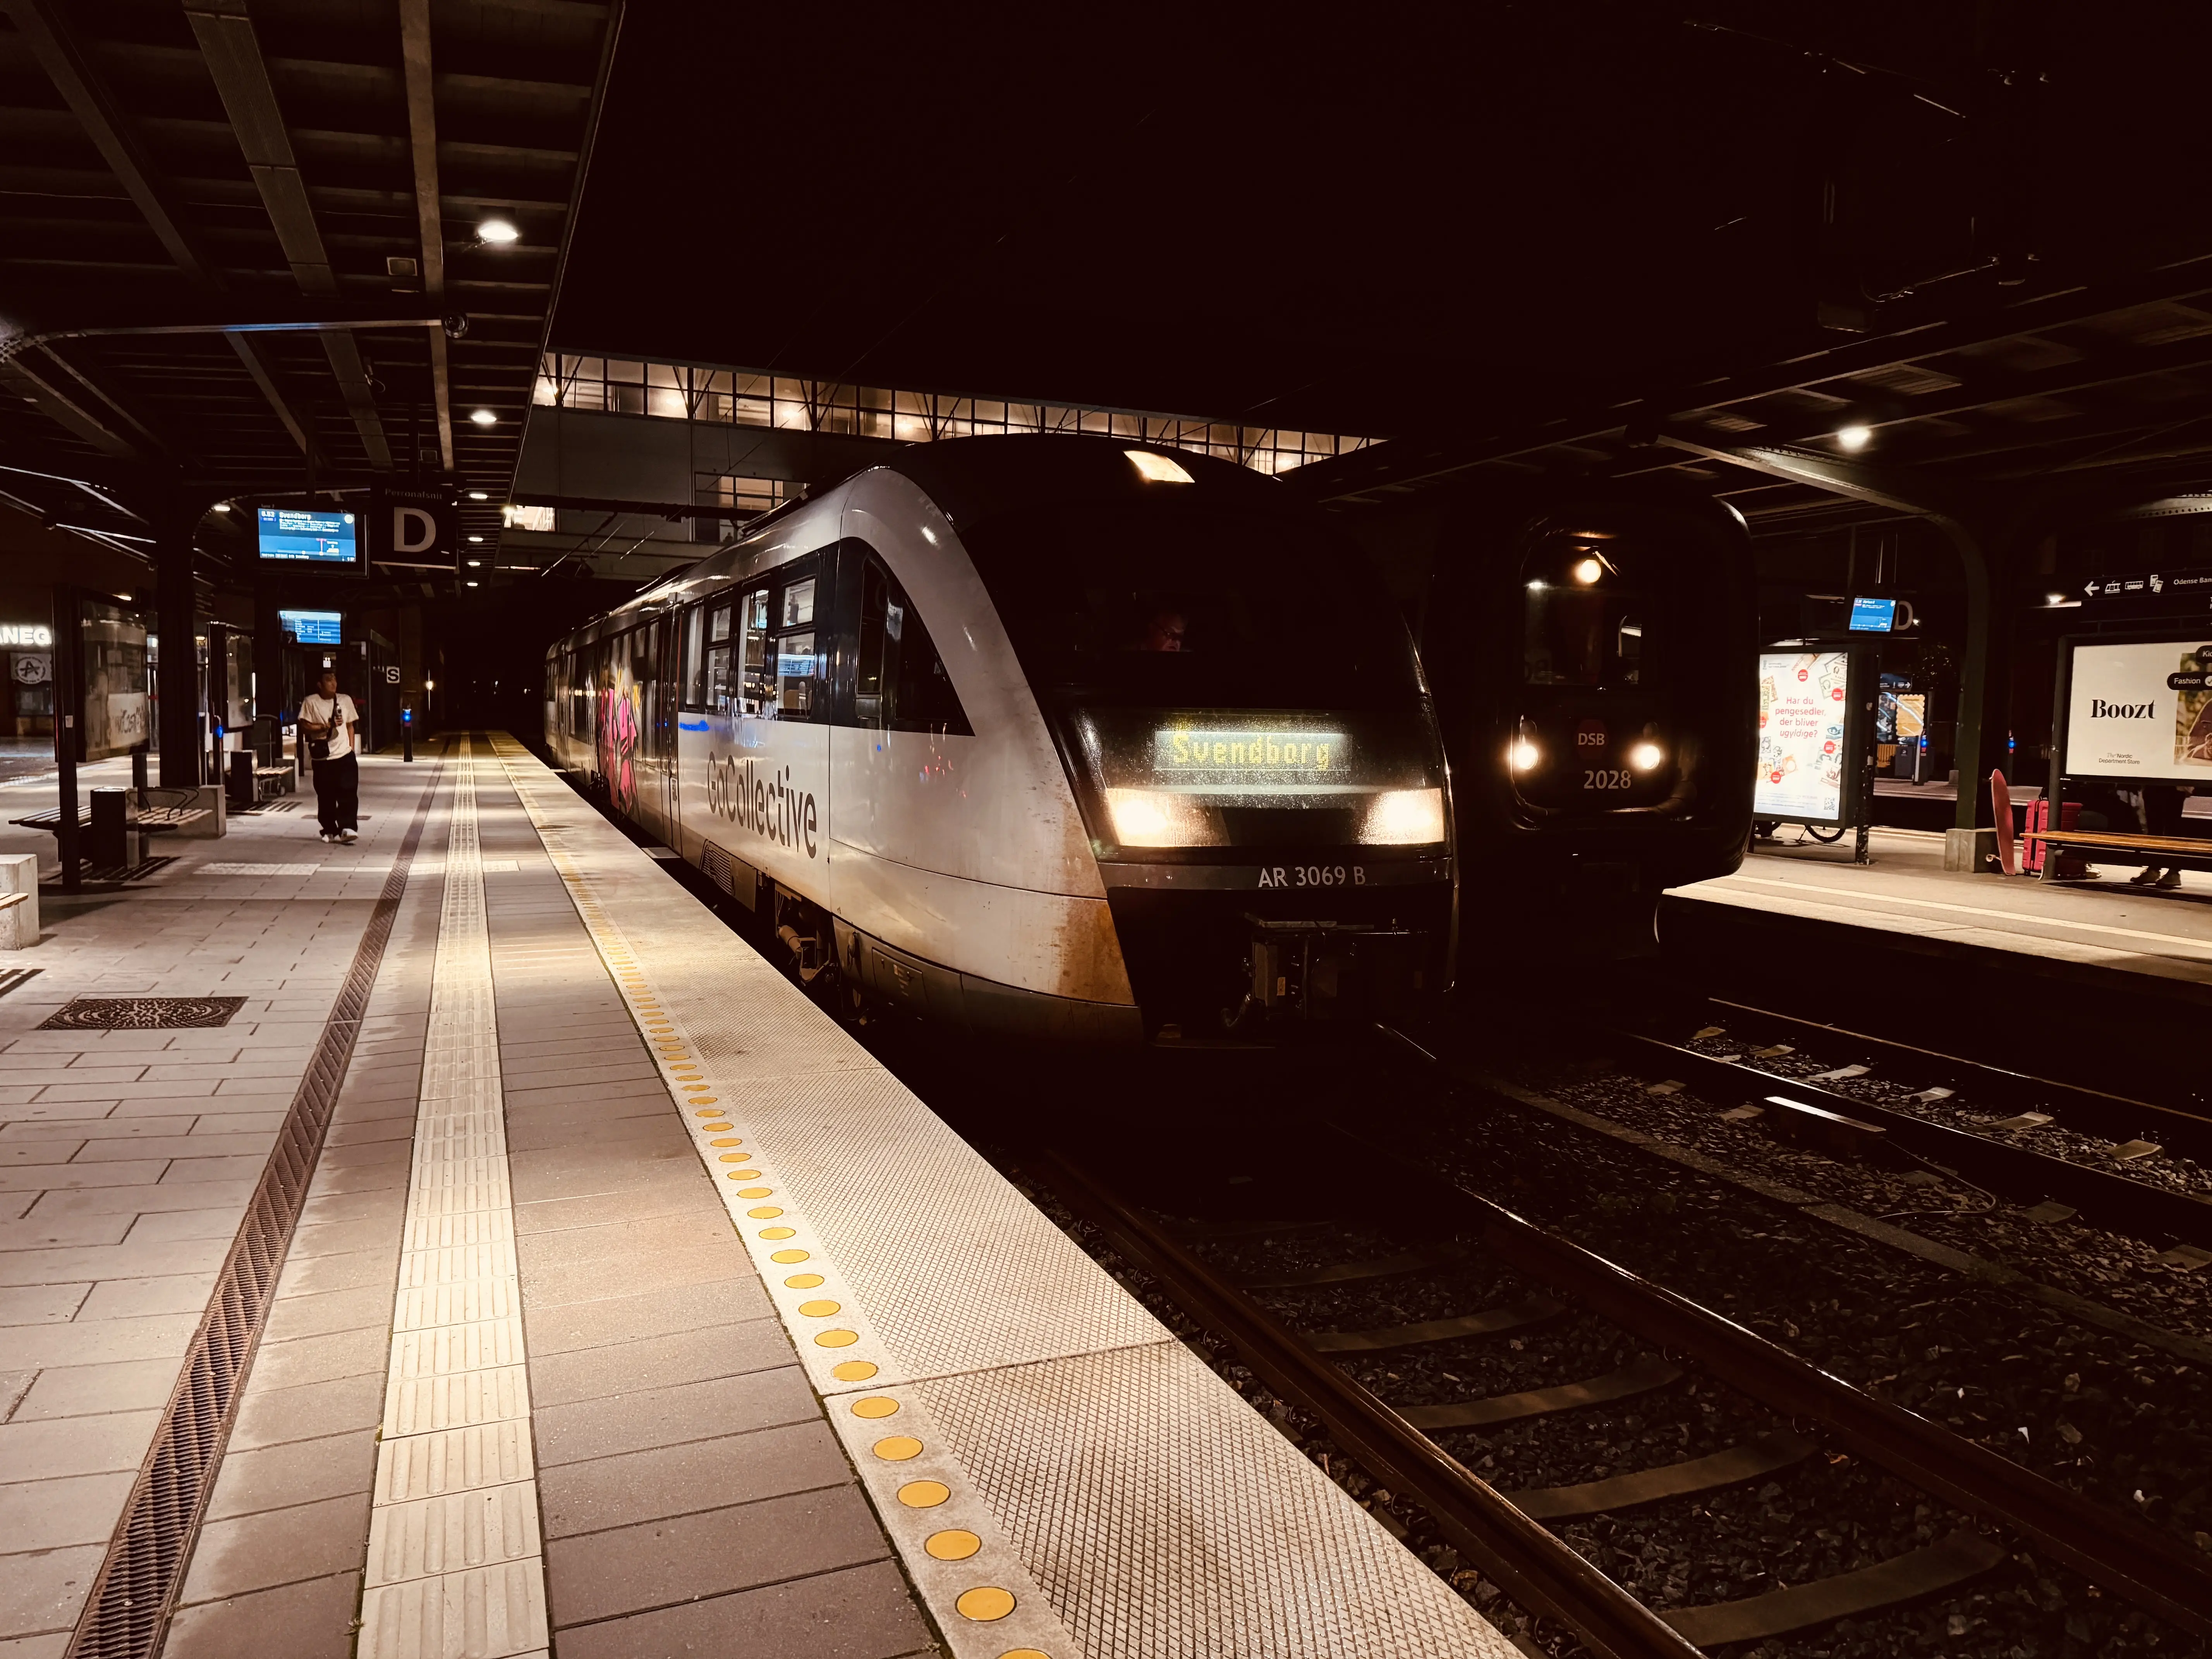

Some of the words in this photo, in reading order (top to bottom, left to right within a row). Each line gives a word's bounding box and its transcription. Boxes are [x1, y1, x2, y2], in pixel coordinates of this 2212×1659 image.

[385, 488, 443, 500] Perronafsnit
[394, 507, 436, 553] D
[1894, 600, 1913, 630] D
[0, 627, 52, 645] NEG
[388, 669, 399, 682] S
[1803, 696, 1814, 704] du
[2090, 699, 2156, 719] Boozt
[1775, 707, 1826, 716] pengesedler,
[1779, 717, 1793, 726] der
[1795, 718, 1819, 726] bliver
[1578, 733, 1605, 745] DSB
[1780, 728, 1818, 739] ugyldige?
[1173, 730, 1329, 771] Svendborg
[1584, 770, 1631, 789] 2028
[708, 751, 817, 859] GoCollective
[1258, 867, 1288, 888] AR
[1295, 866, 1345, 886] 3069
[1353, 866, 1365, 885] B
